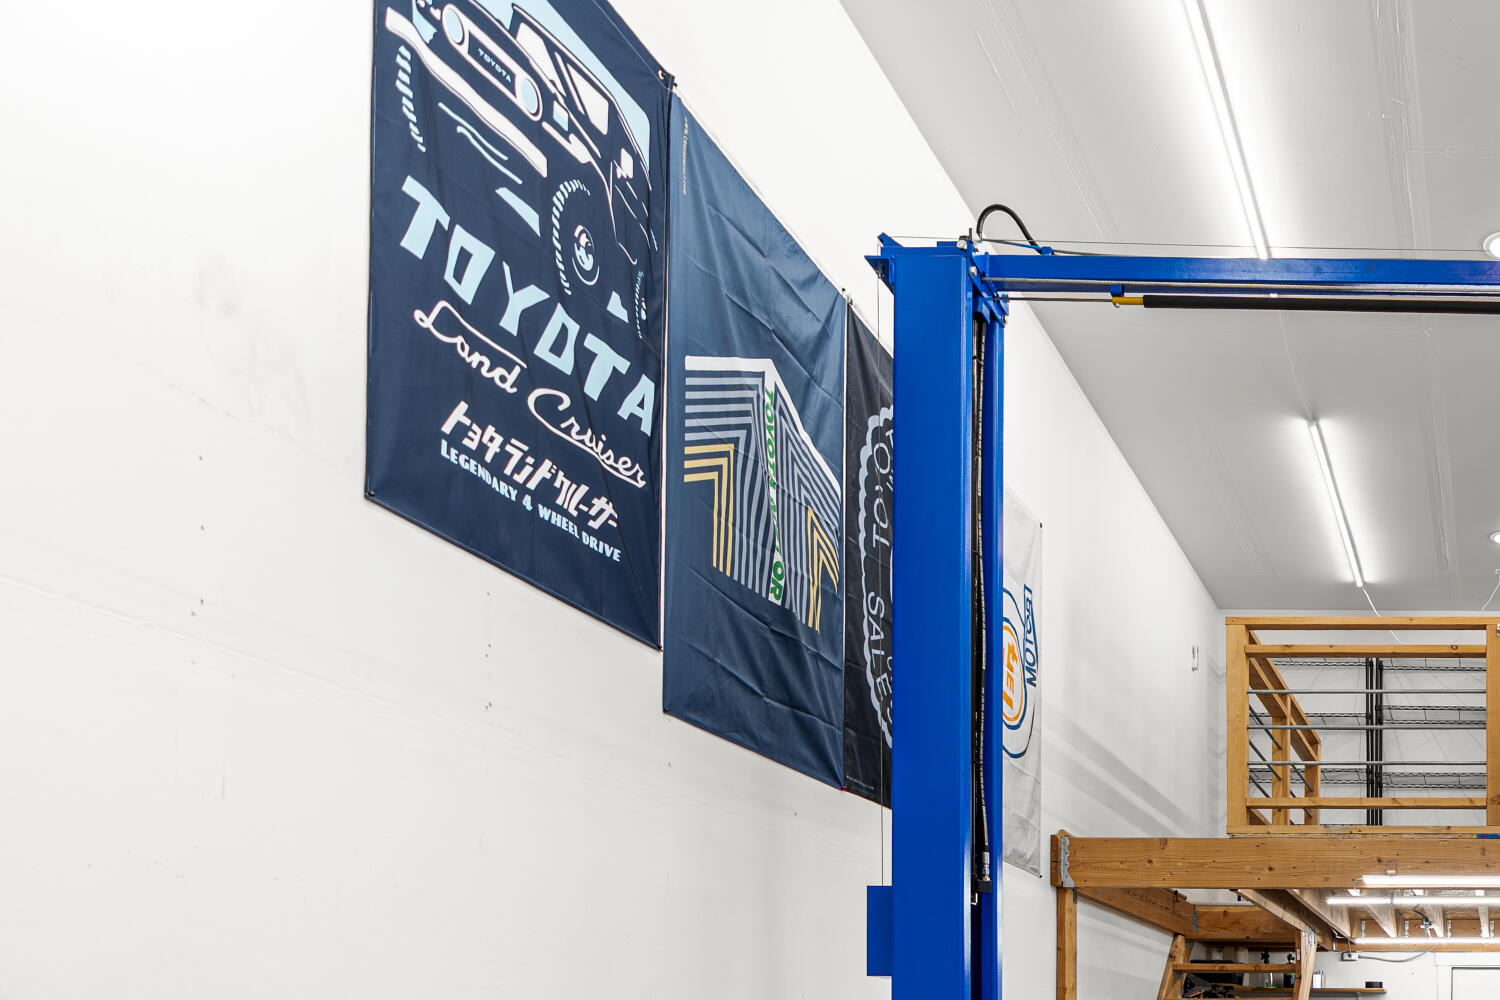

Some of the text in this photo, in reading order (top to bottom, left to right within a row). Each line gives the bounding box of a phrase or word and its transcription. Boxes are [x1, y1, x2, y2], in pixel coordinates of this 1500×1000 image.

[477, 47, 513, 84] TOYOTA
[400, 175, 655, 437] TOYOTA
[413, 300, 647, 488] Land Cruiser
[764, 387, 777, 490] TOYOTA
[522, 494, 533, 512] 4
[537, 503, 580, 540] WHEEL
[581, 531, 622, 562] DRIVE
